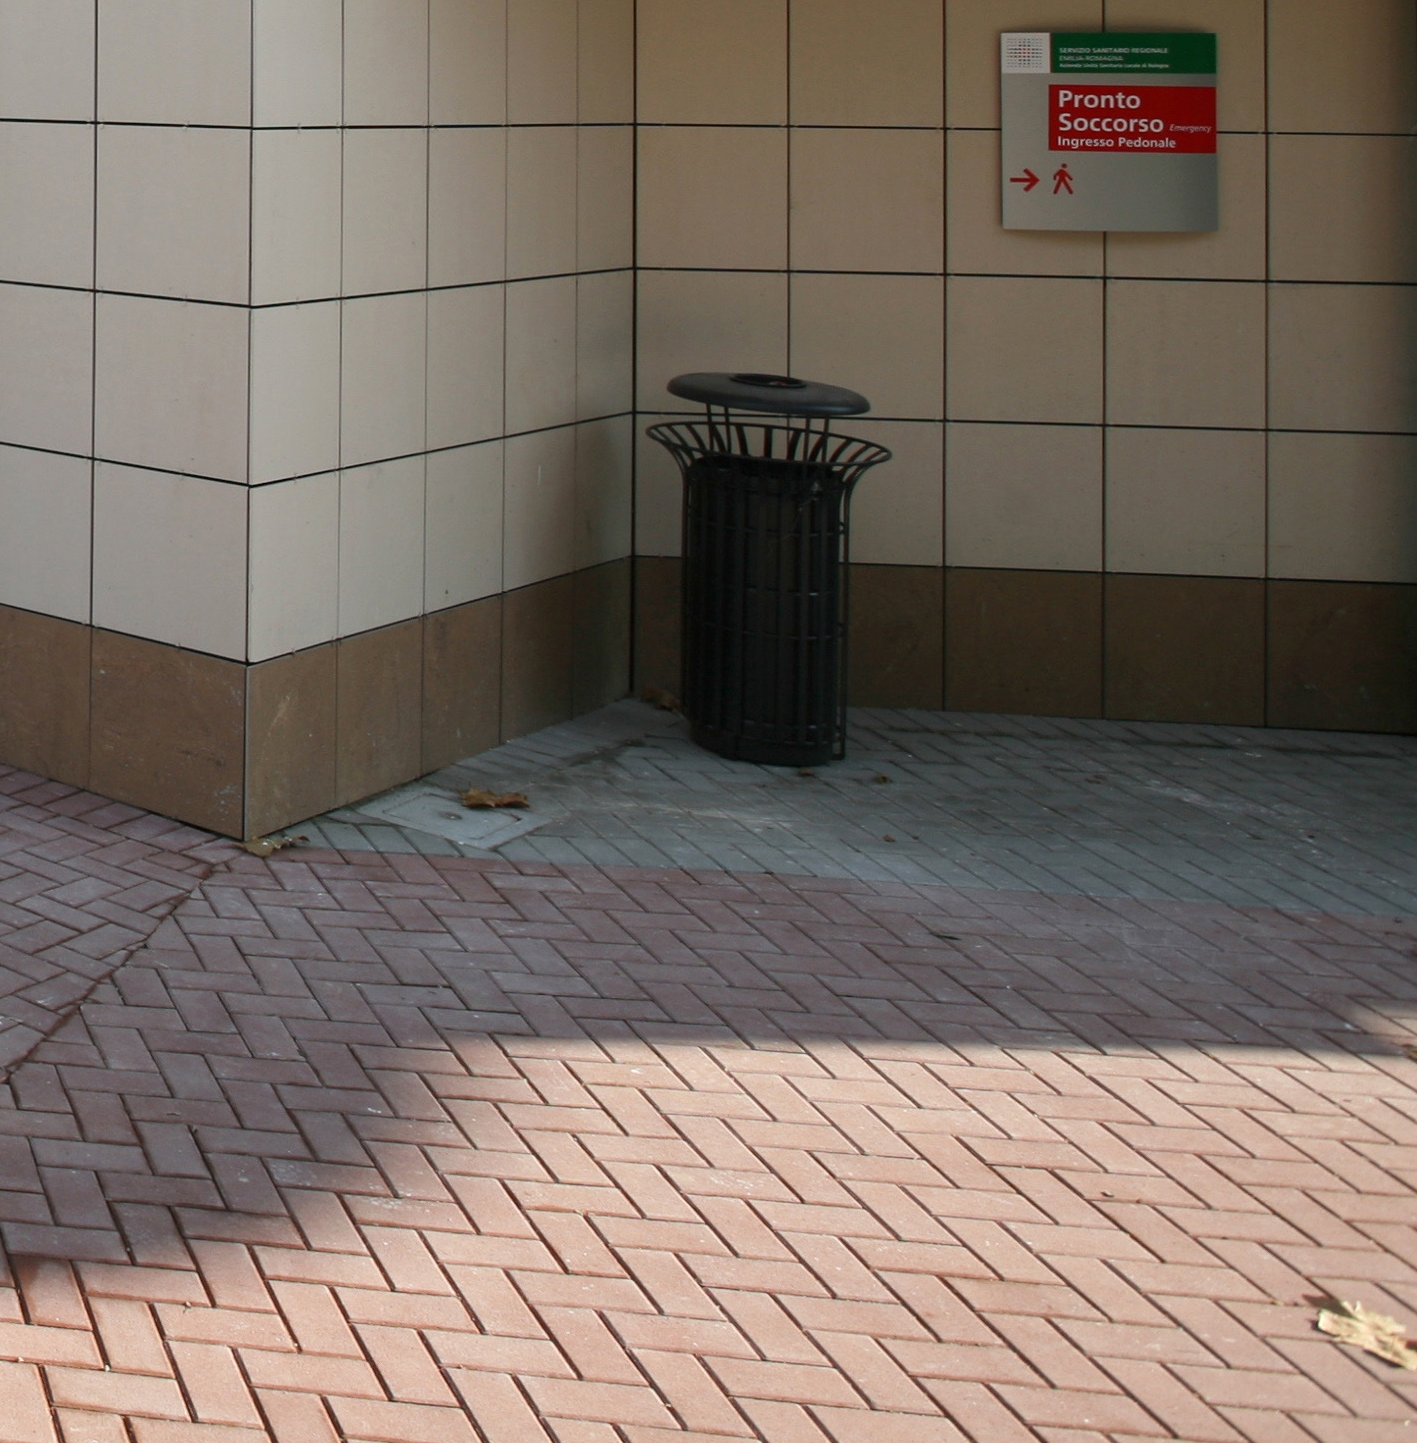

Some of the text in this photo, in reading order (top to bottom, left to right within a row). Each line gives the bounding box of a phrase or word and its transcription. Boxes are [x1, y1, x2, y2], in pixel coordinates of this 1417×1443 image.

[1058, 89, 1141, 109] Pronto
[1058, 113, 1212, 134] Soccorso Emergency
[1057, 135, 1176, 149] Ingresso Pedonale
